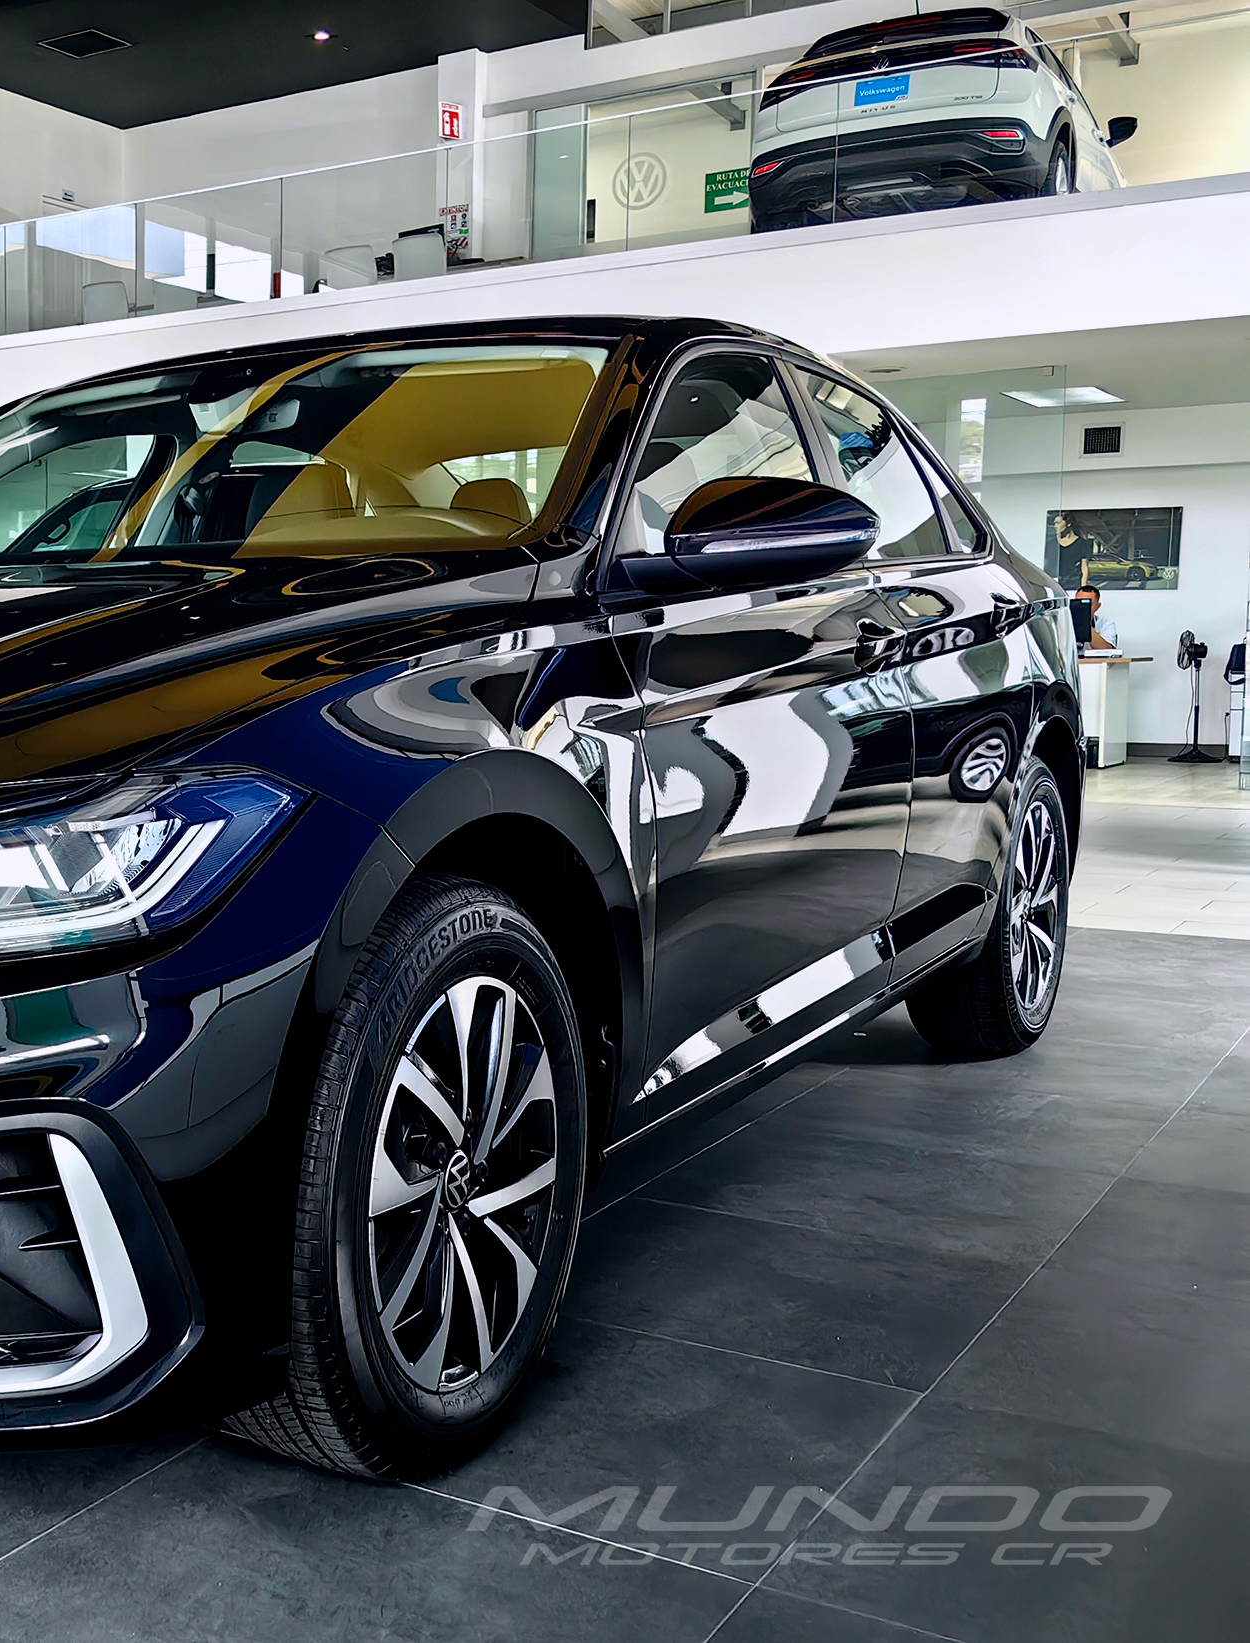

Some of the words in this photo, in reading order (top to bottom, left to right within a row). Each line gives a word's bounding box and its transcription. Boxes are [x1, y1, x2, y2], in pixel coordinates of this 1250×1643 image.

[859, 84, 905, 97] Volkswagen
[716, 172, 739, 181] RUTA
[706, 179, 748, 191] EVACUACI
